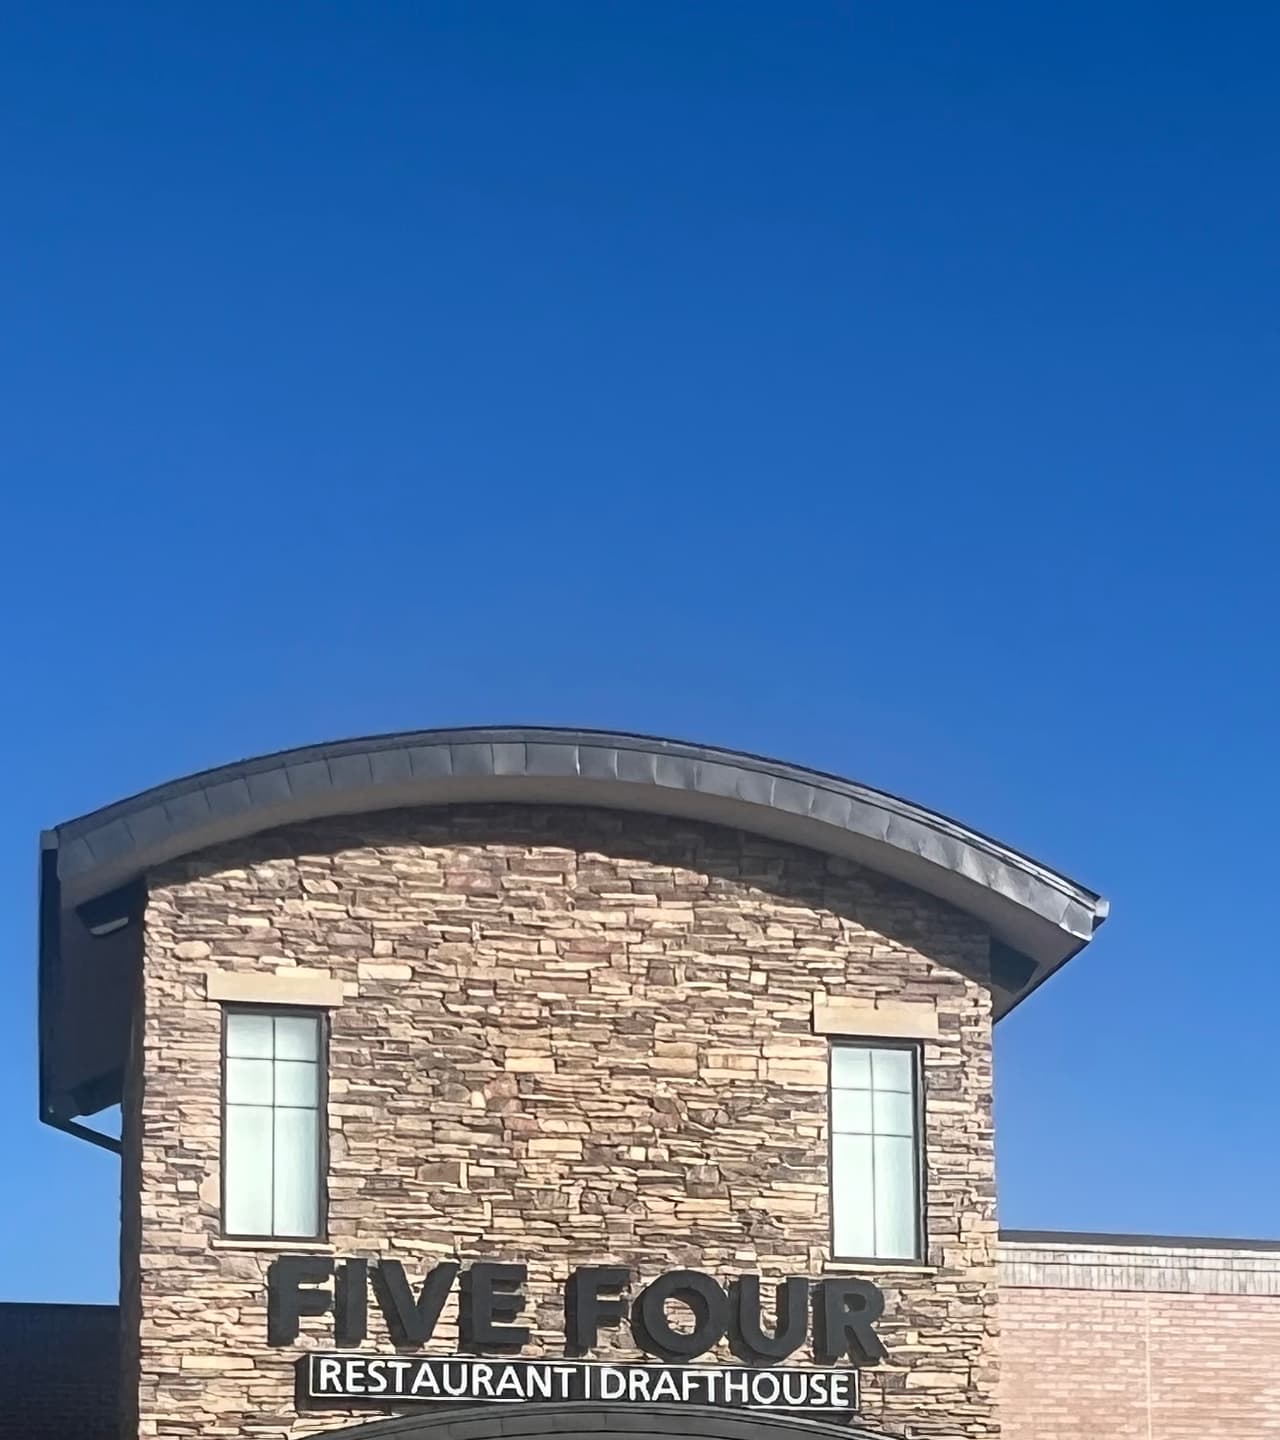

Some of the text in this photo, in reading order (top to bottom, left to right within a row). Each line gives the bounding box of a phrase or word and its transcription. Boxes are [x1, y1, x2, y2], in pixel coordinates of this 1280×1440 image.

[268, 1255, 889, 1365] FIVE FOUR
[318, 1360, 850, 1408] RESTAURANT DRAFTHOUSE
